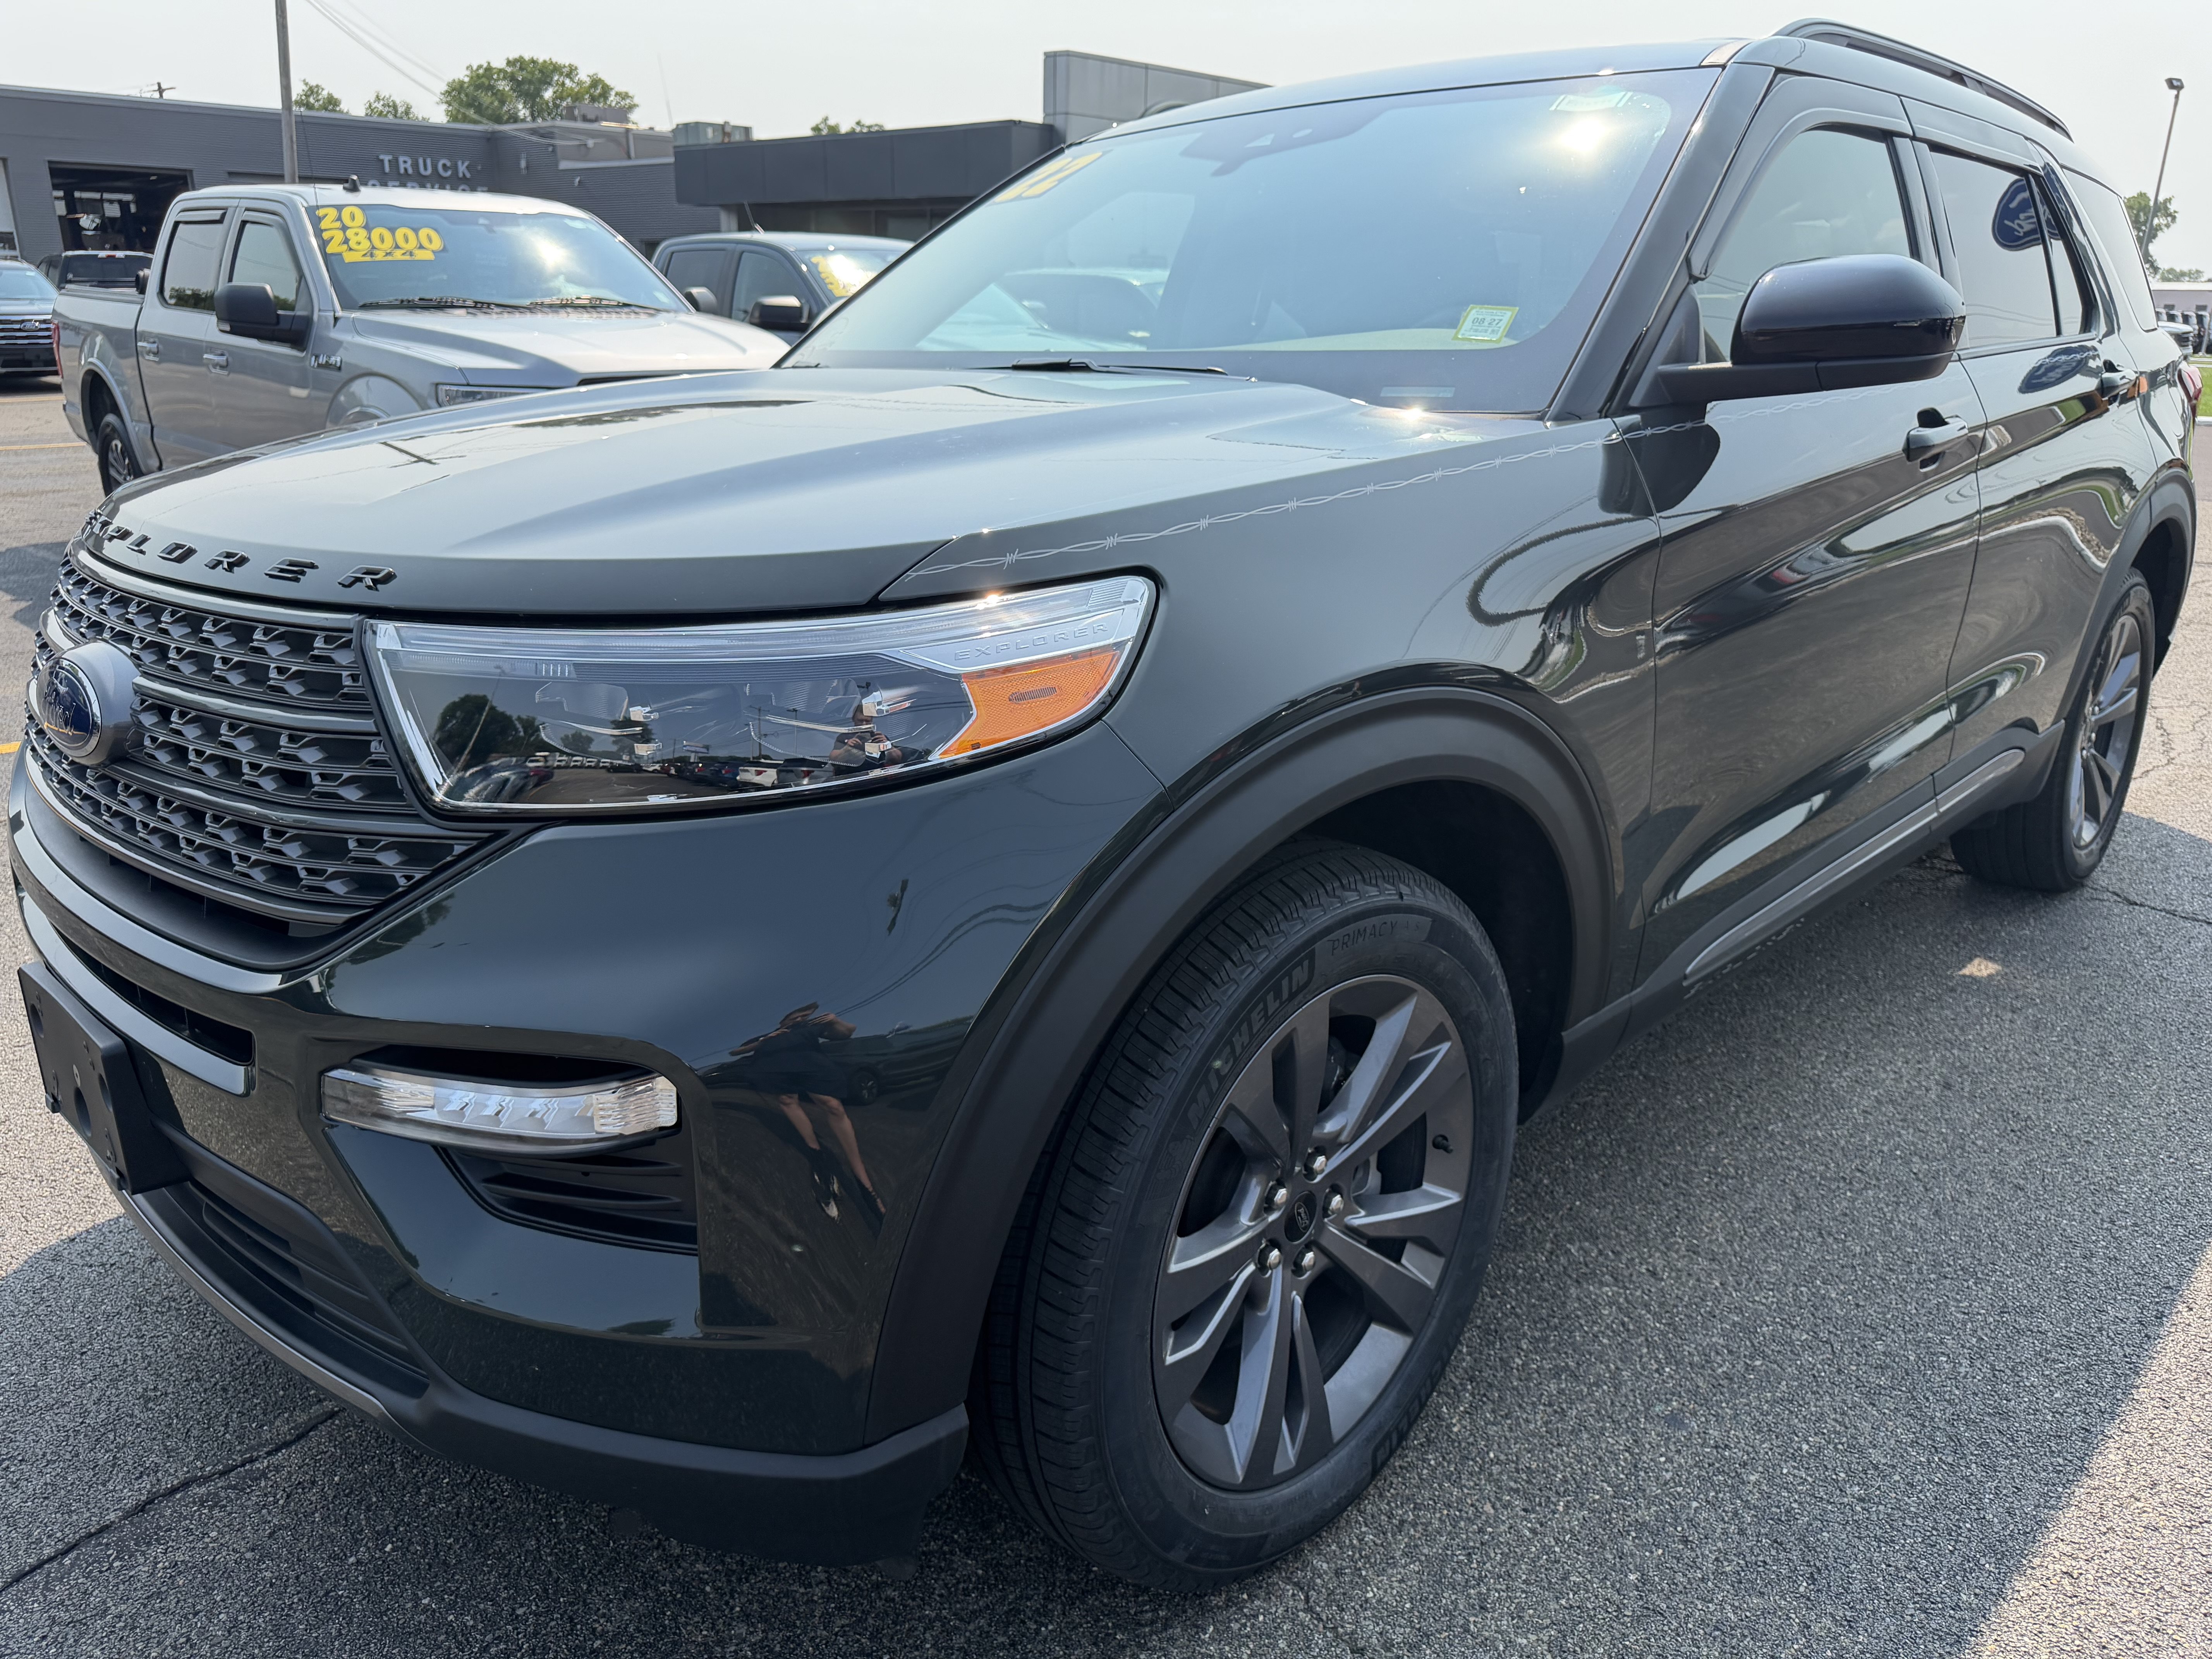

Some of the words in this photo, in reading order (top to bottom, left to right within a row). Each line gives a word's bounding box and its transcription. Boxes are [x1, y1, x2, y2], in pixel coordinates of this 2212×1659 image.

[378, 154, 471, 179] TRUCK
[316, 206, 366, 229] 20
[322, 227, 444, 254] 28000
[954, 622, 1109, 661] EXPLORER
[1327, 920, 1398, 956] PRIMACY
[1187, 958, 1310, 1131] MICHELIN
